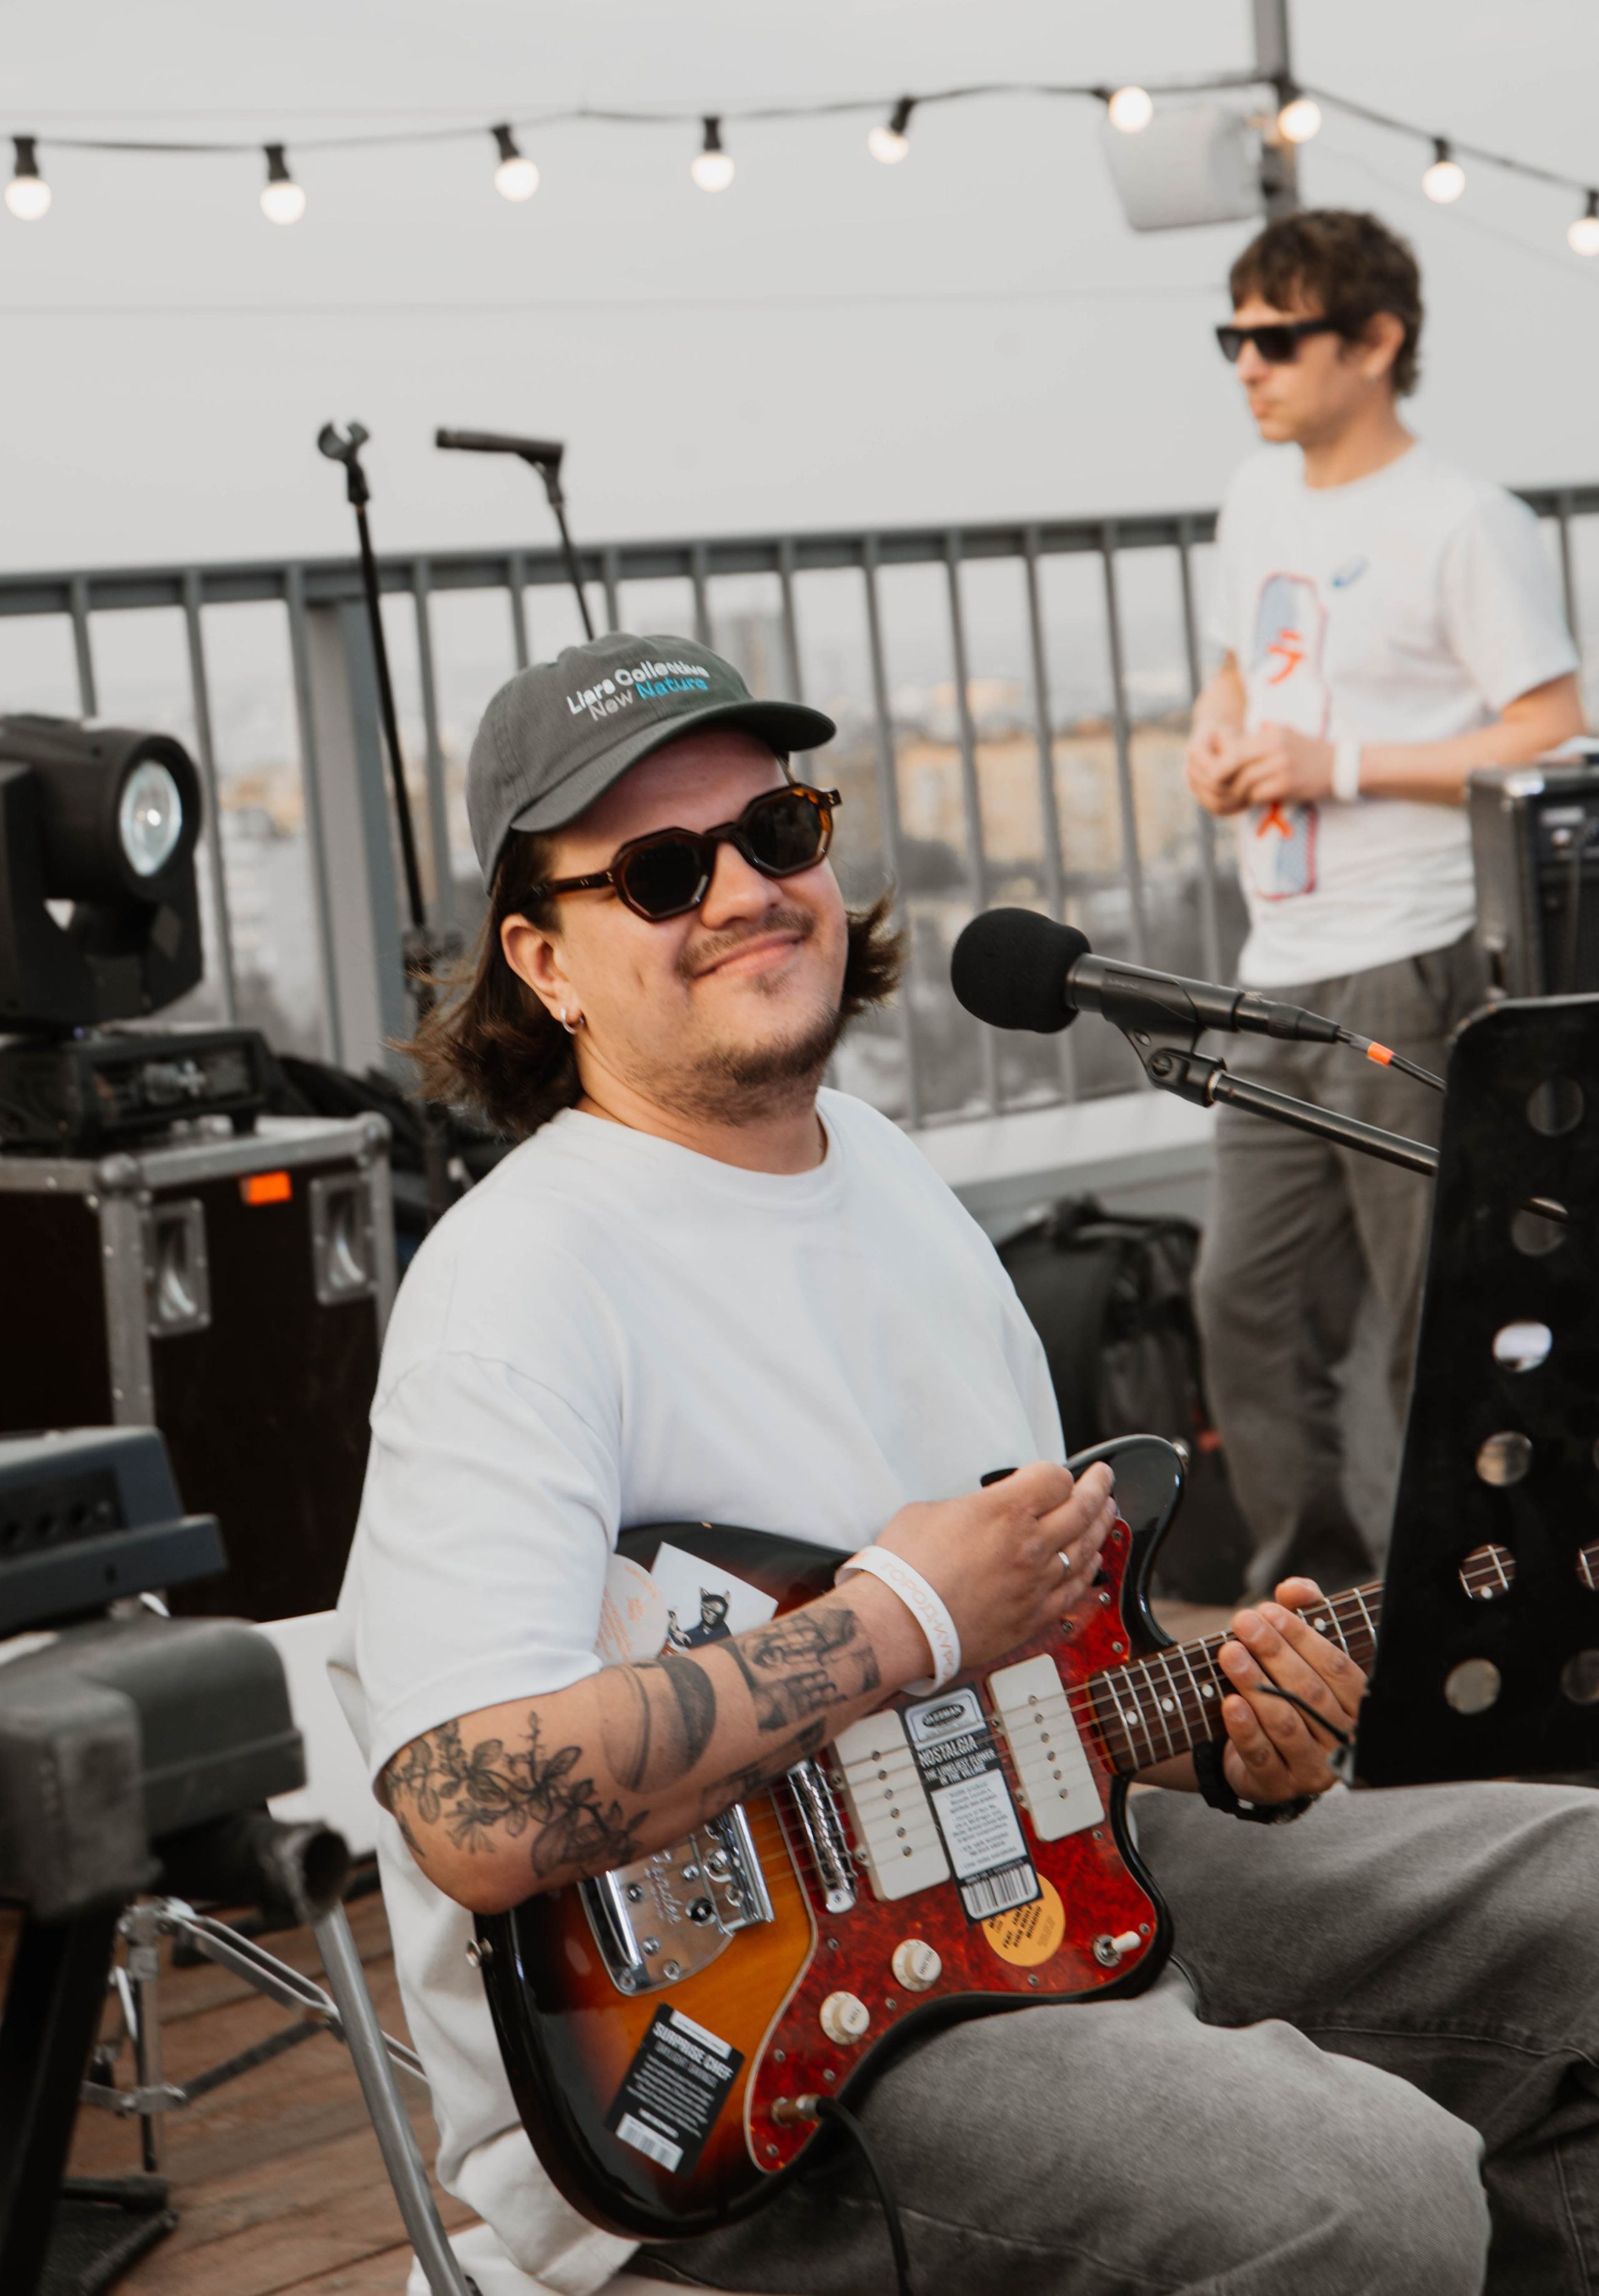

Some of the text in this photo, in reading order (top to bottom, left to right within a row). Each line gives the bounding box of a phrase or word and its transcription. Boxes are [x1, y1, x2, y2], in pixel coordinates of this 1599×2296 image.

[615, 660, 710, 686] Collective
[588, 676, 708, 721] New Nature
[918, 1733, 978, 1768] NOSTALGIA
[653, 2021, 706, 2064] SURPRISE
[703, 2054, 734, 2081] CHEF
